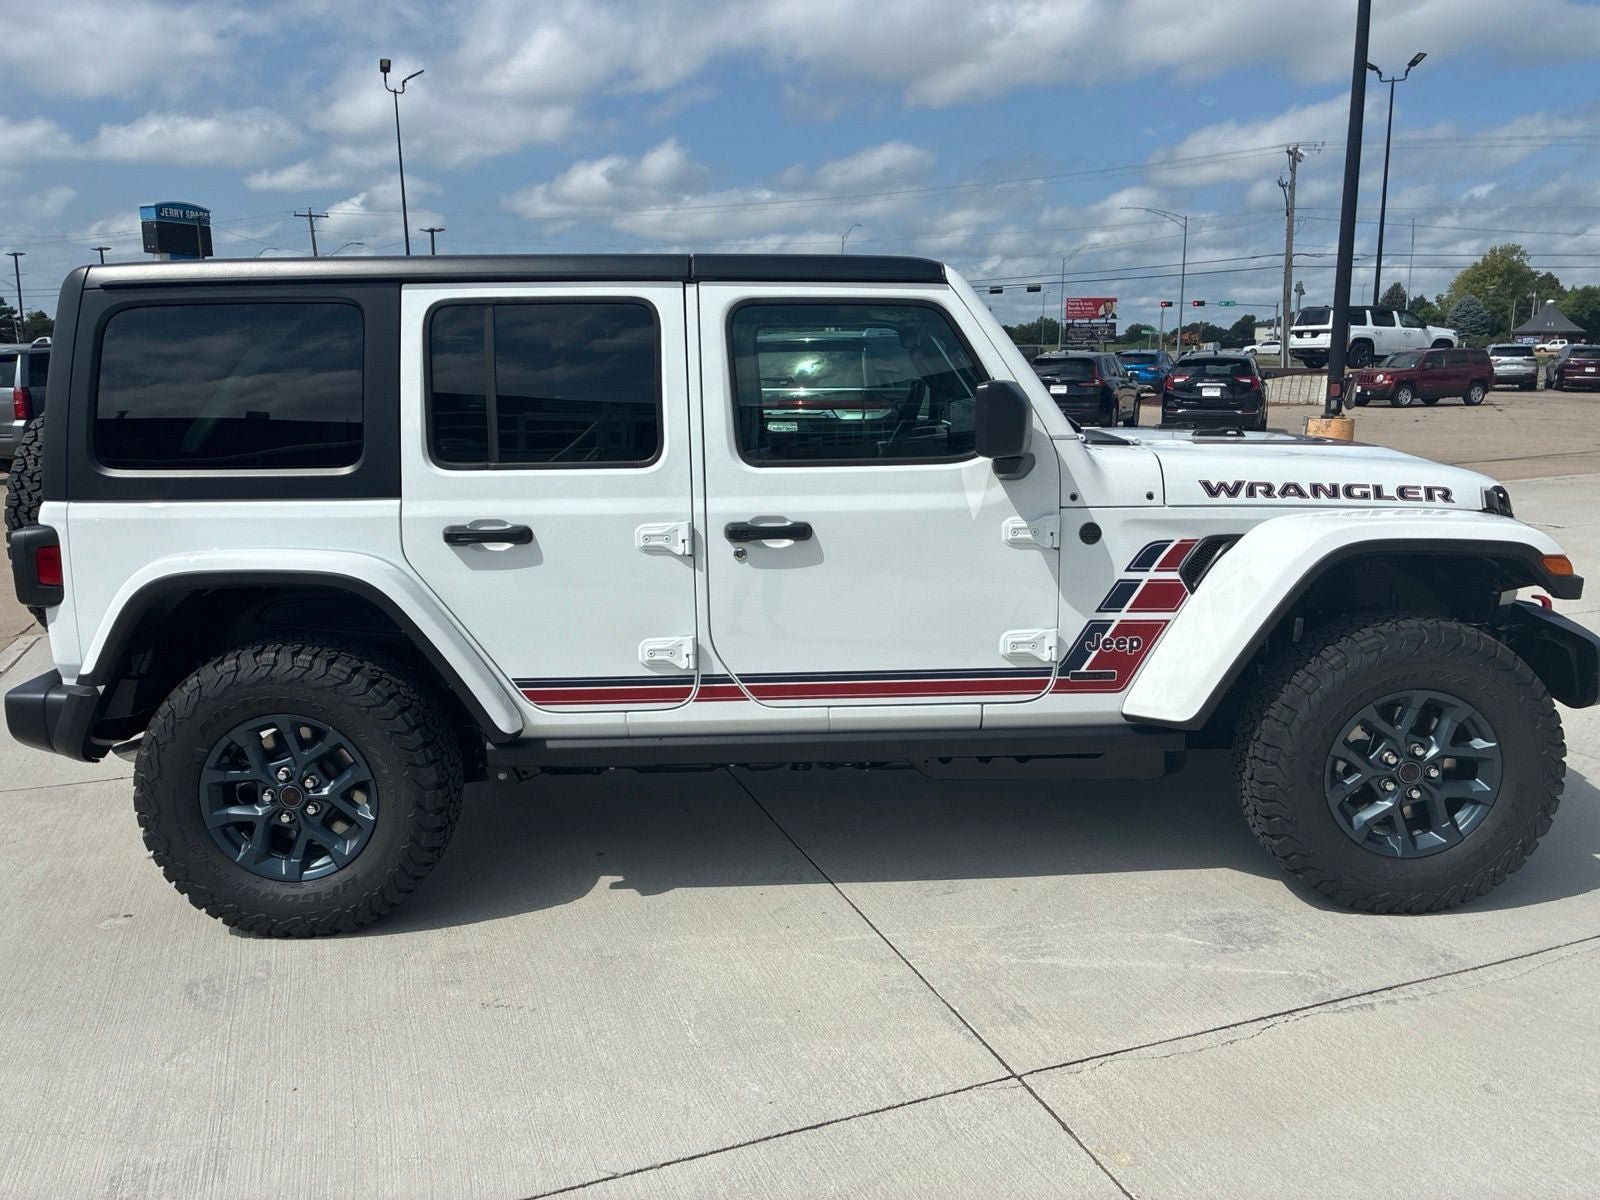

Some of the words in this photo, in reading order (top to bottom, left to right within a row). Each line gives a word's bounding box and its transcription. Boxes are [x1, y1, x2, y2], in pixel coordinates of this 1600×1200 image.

[160, 207, 183, 218] JERRY
[1198, 479, 1455, 504] WRANGLER
[1084, 632, 1144, 655] Jeep
